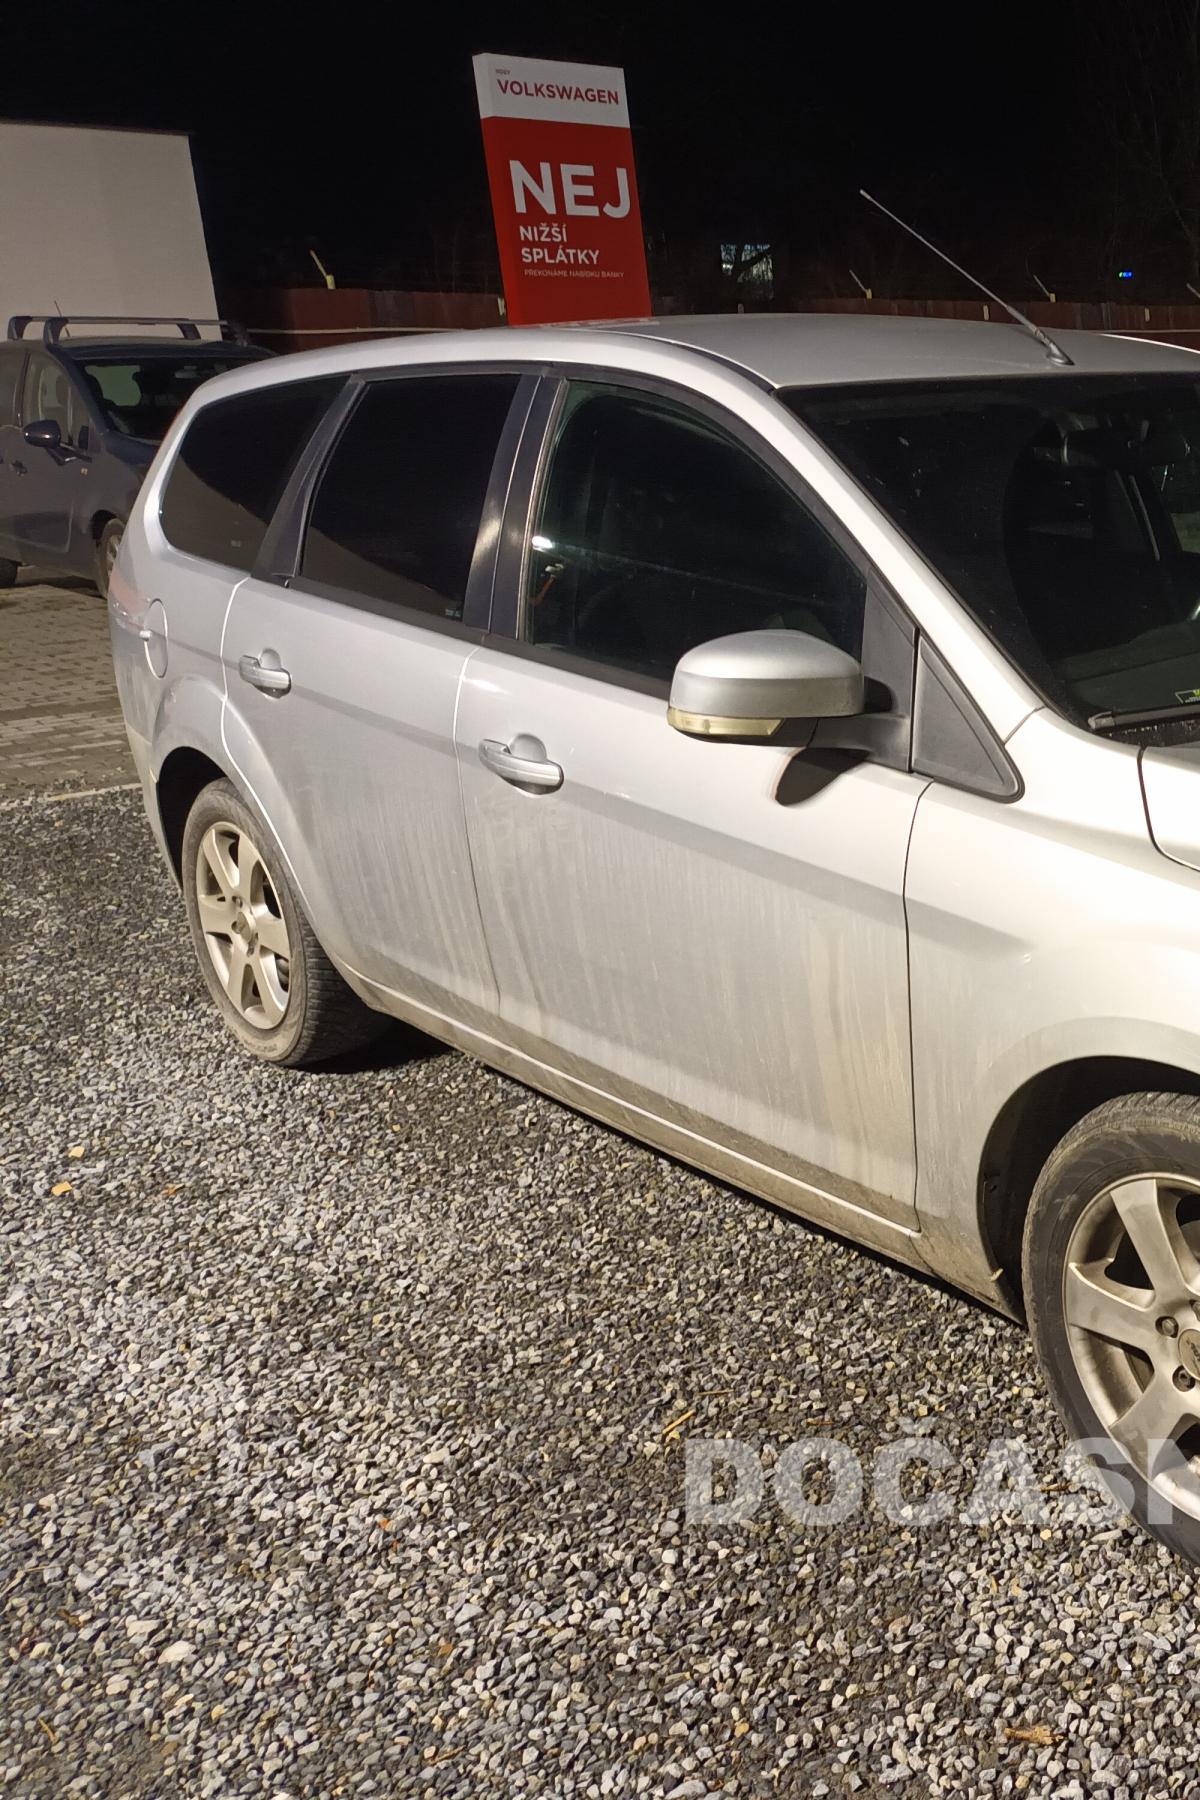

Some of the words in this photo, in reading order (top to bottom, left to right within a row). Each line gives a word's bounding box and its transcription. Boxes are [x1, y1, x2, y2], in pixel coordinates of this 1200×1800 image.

[496, 79, 619, 104] VOLKSWAGEN
[509, 160, 631, 218] NEJ
[519, 222, 568, 243] NIŽŠÍ
[521, 245, 600, 265] SPLÁTKY
